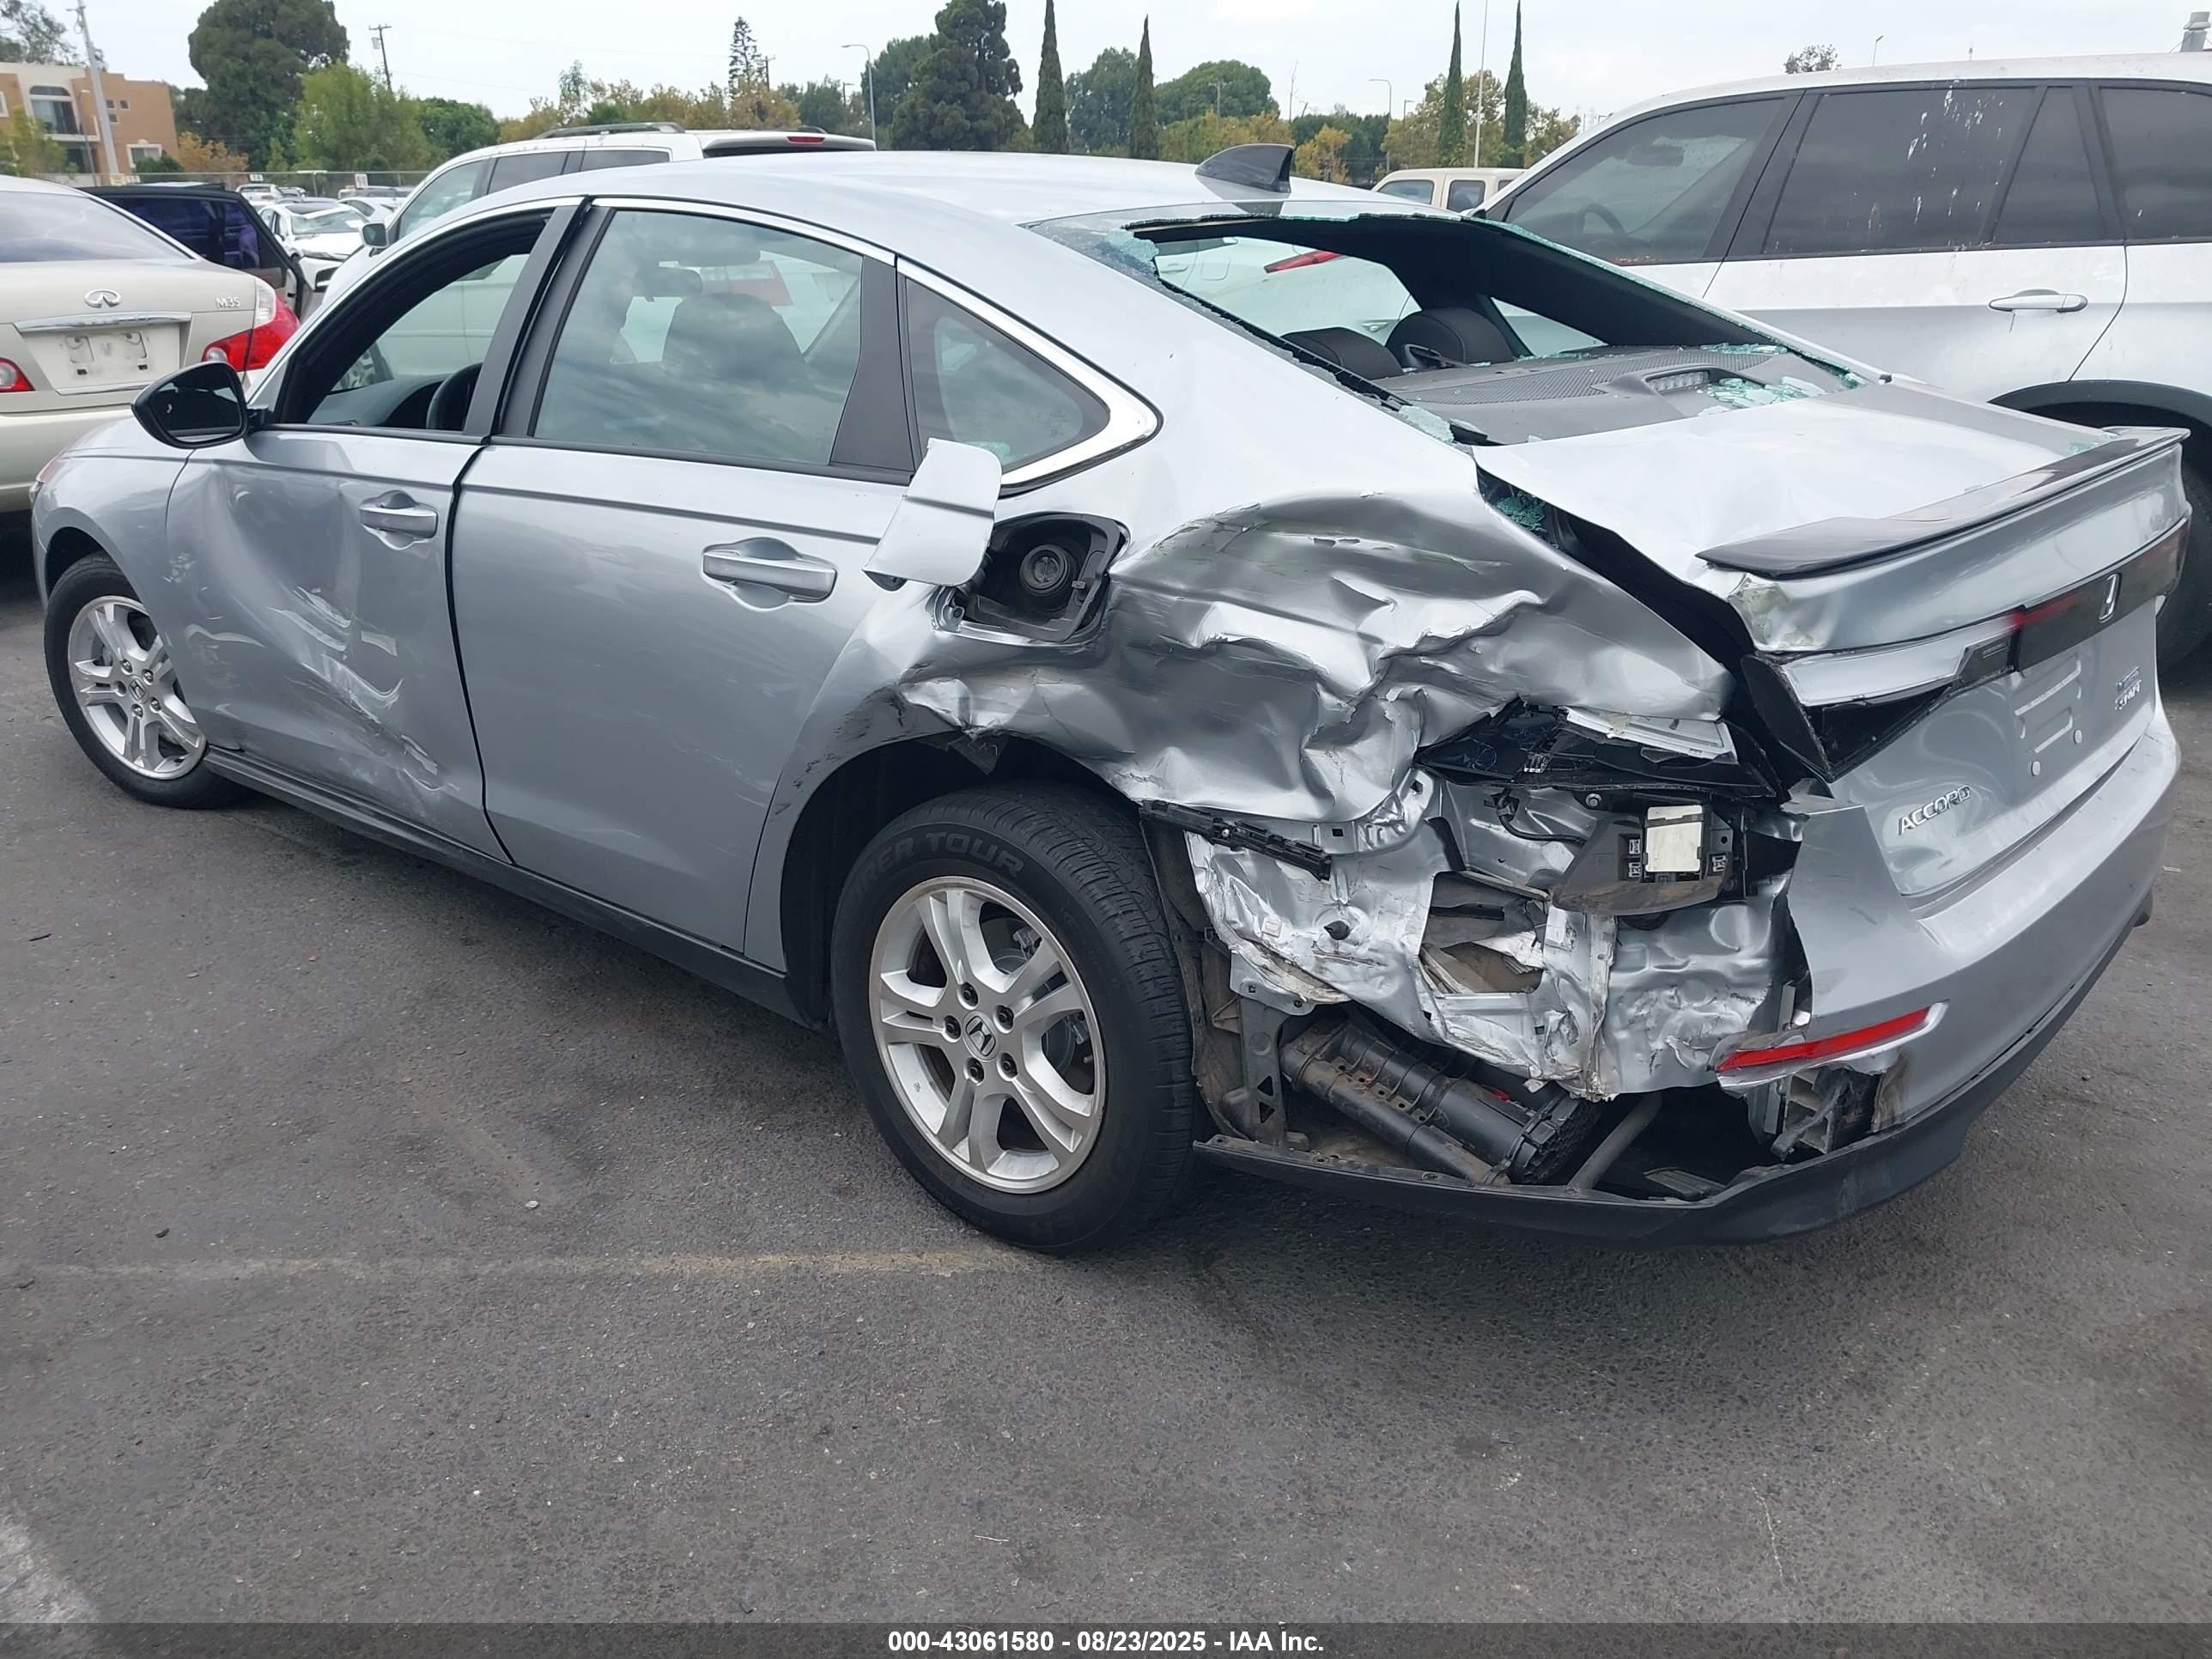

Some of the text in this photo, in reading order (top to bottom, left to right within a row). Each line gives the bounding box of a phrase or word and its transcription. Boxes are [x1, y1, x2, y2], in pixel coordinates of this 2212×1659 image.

[216, 296, 240, 308] M35
[1899, 784, 1972, 836] ACCORD
[926, 831, 1025, 878] TOUR
